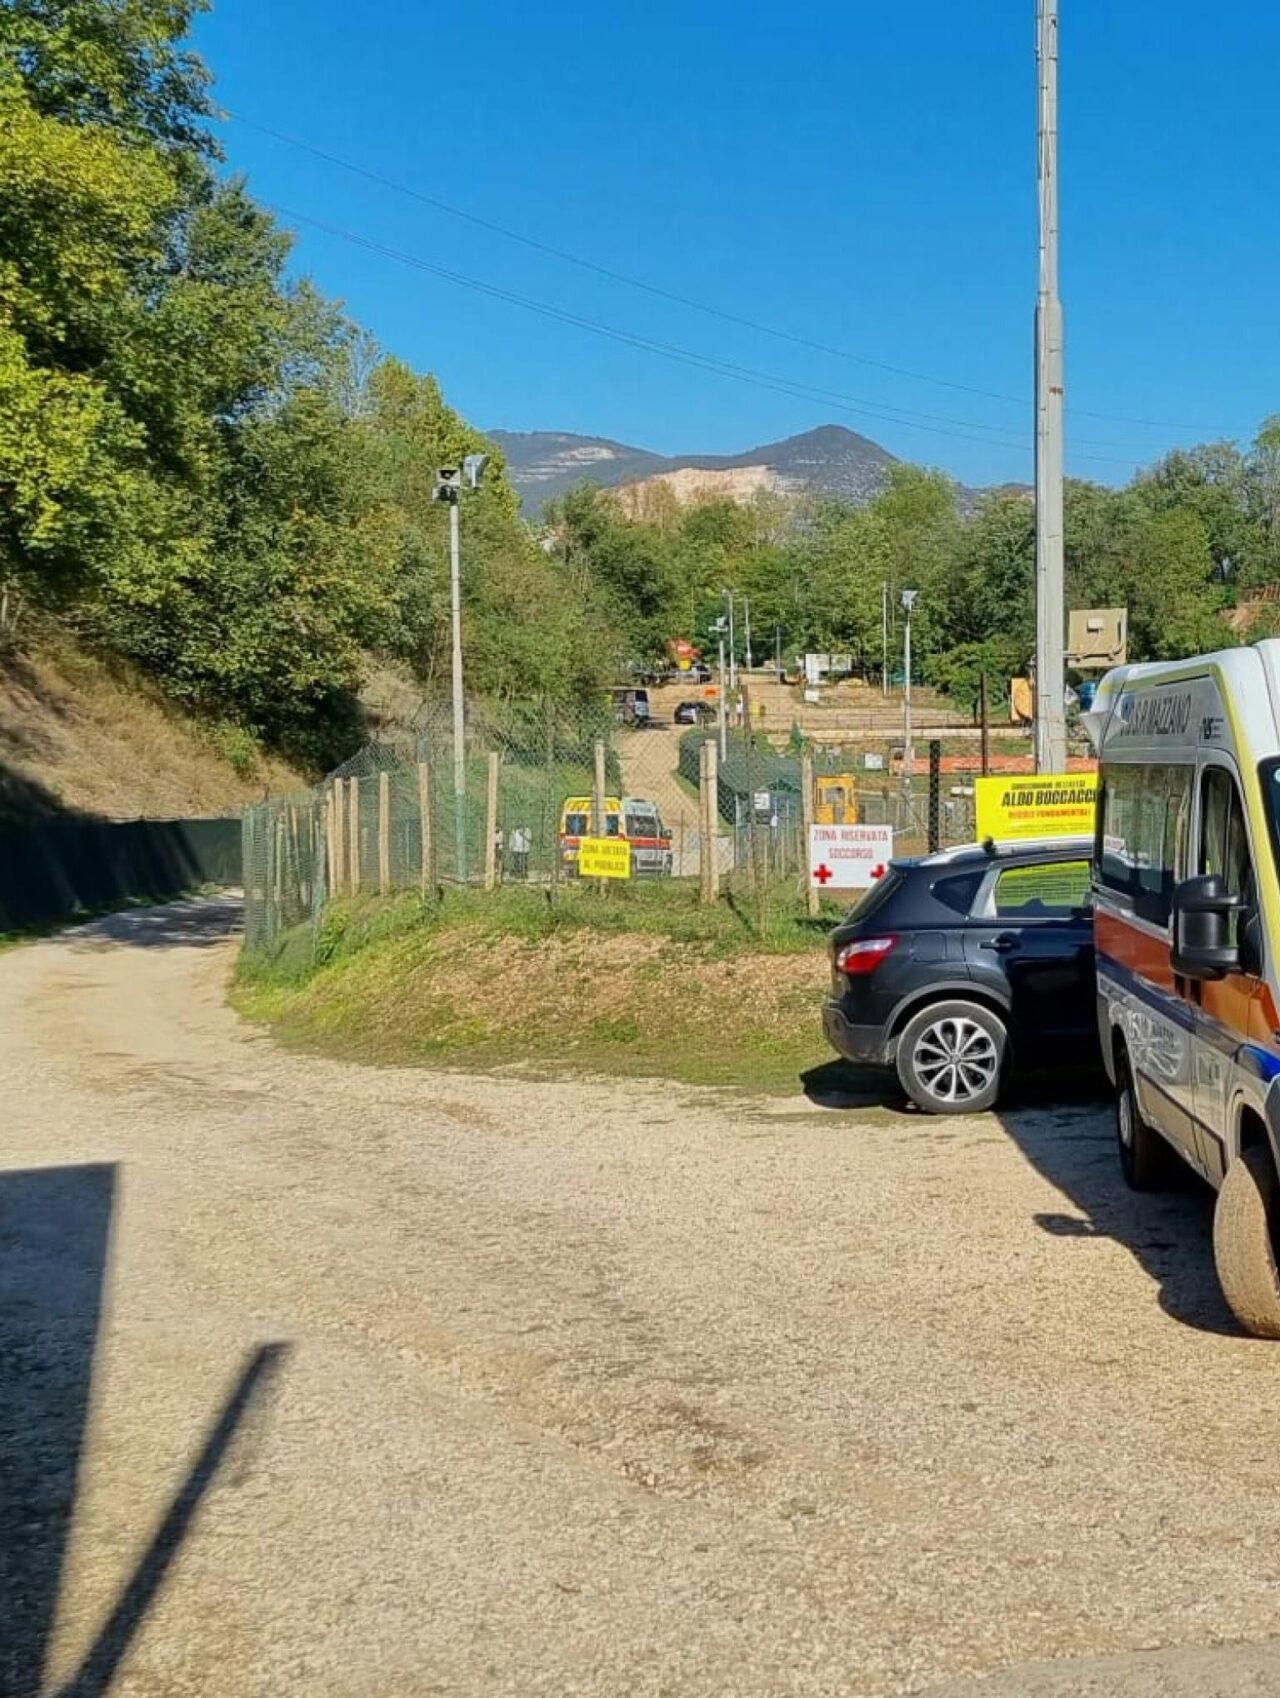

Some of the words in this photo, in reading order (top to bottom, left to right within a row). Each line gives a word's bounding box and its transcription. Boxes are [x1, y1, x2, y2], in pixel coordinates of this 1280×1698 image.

[1001, 790, 1034, 807] ALDO
[814, 829, 837, 841] ZONA
[841, 829, 889, 842] RISERVATA
[828, 847, 874, 859] SOCCORSO
